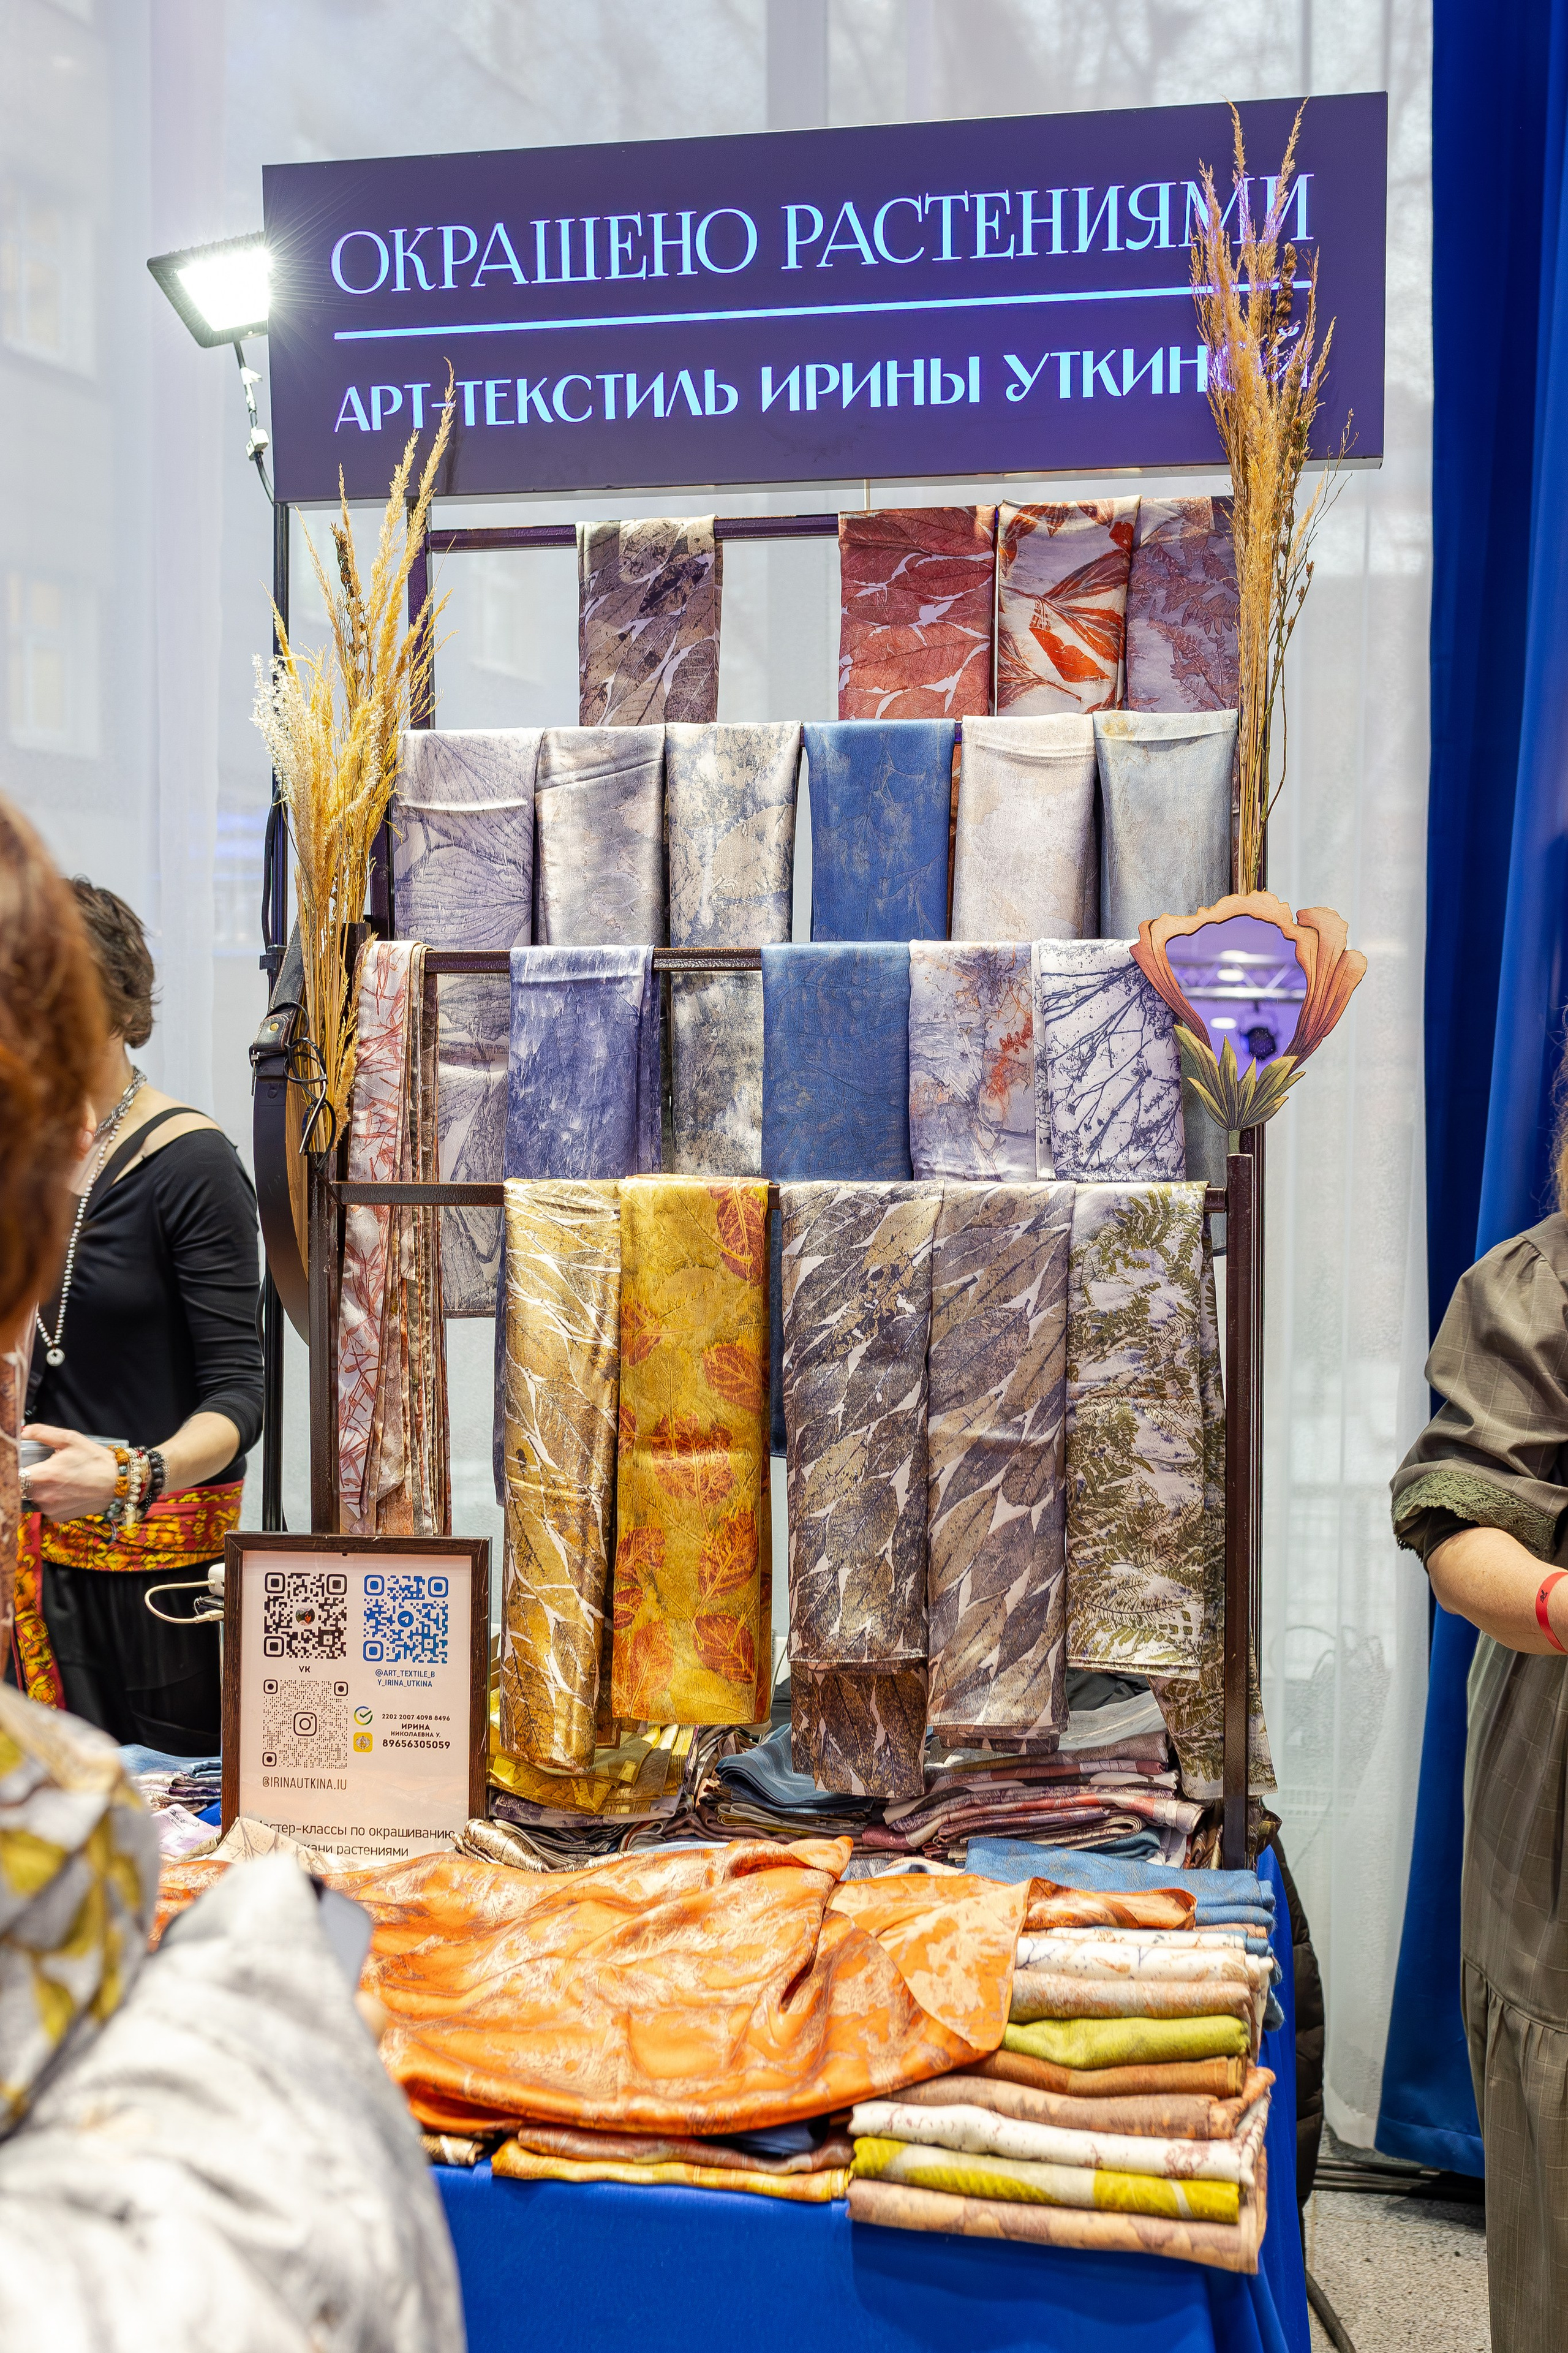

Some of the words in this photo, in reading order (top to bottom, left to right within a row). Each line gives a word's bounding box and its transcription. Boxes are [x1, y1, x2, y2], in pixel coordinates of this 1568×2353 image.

[331, 208, 758, 295] ОКРАШЕНО
[780, 174, 1315, 271] РАСТЕНИЯМИ
[334, 369, 739, 433] АРТ-ТЕКСТИЛЬ
[761, 355, 980, 414] ИРИНЫ
[1003, 327, 1311, 402] УТКИН
[375, 1669, 435, 1678] @ART_TEXTILE_B
[382, 1739, 451, 1749] 89656305059
[262, 1776, 347, 1790] @IRINAUTKINA.IU
[259, 1820, 347, 1837] стер-классы
[350, 1827, 365, 1836] по
[369, 1827, 455, 1840] окрашиванию
[336, 1845, 409, 1856] растениями
